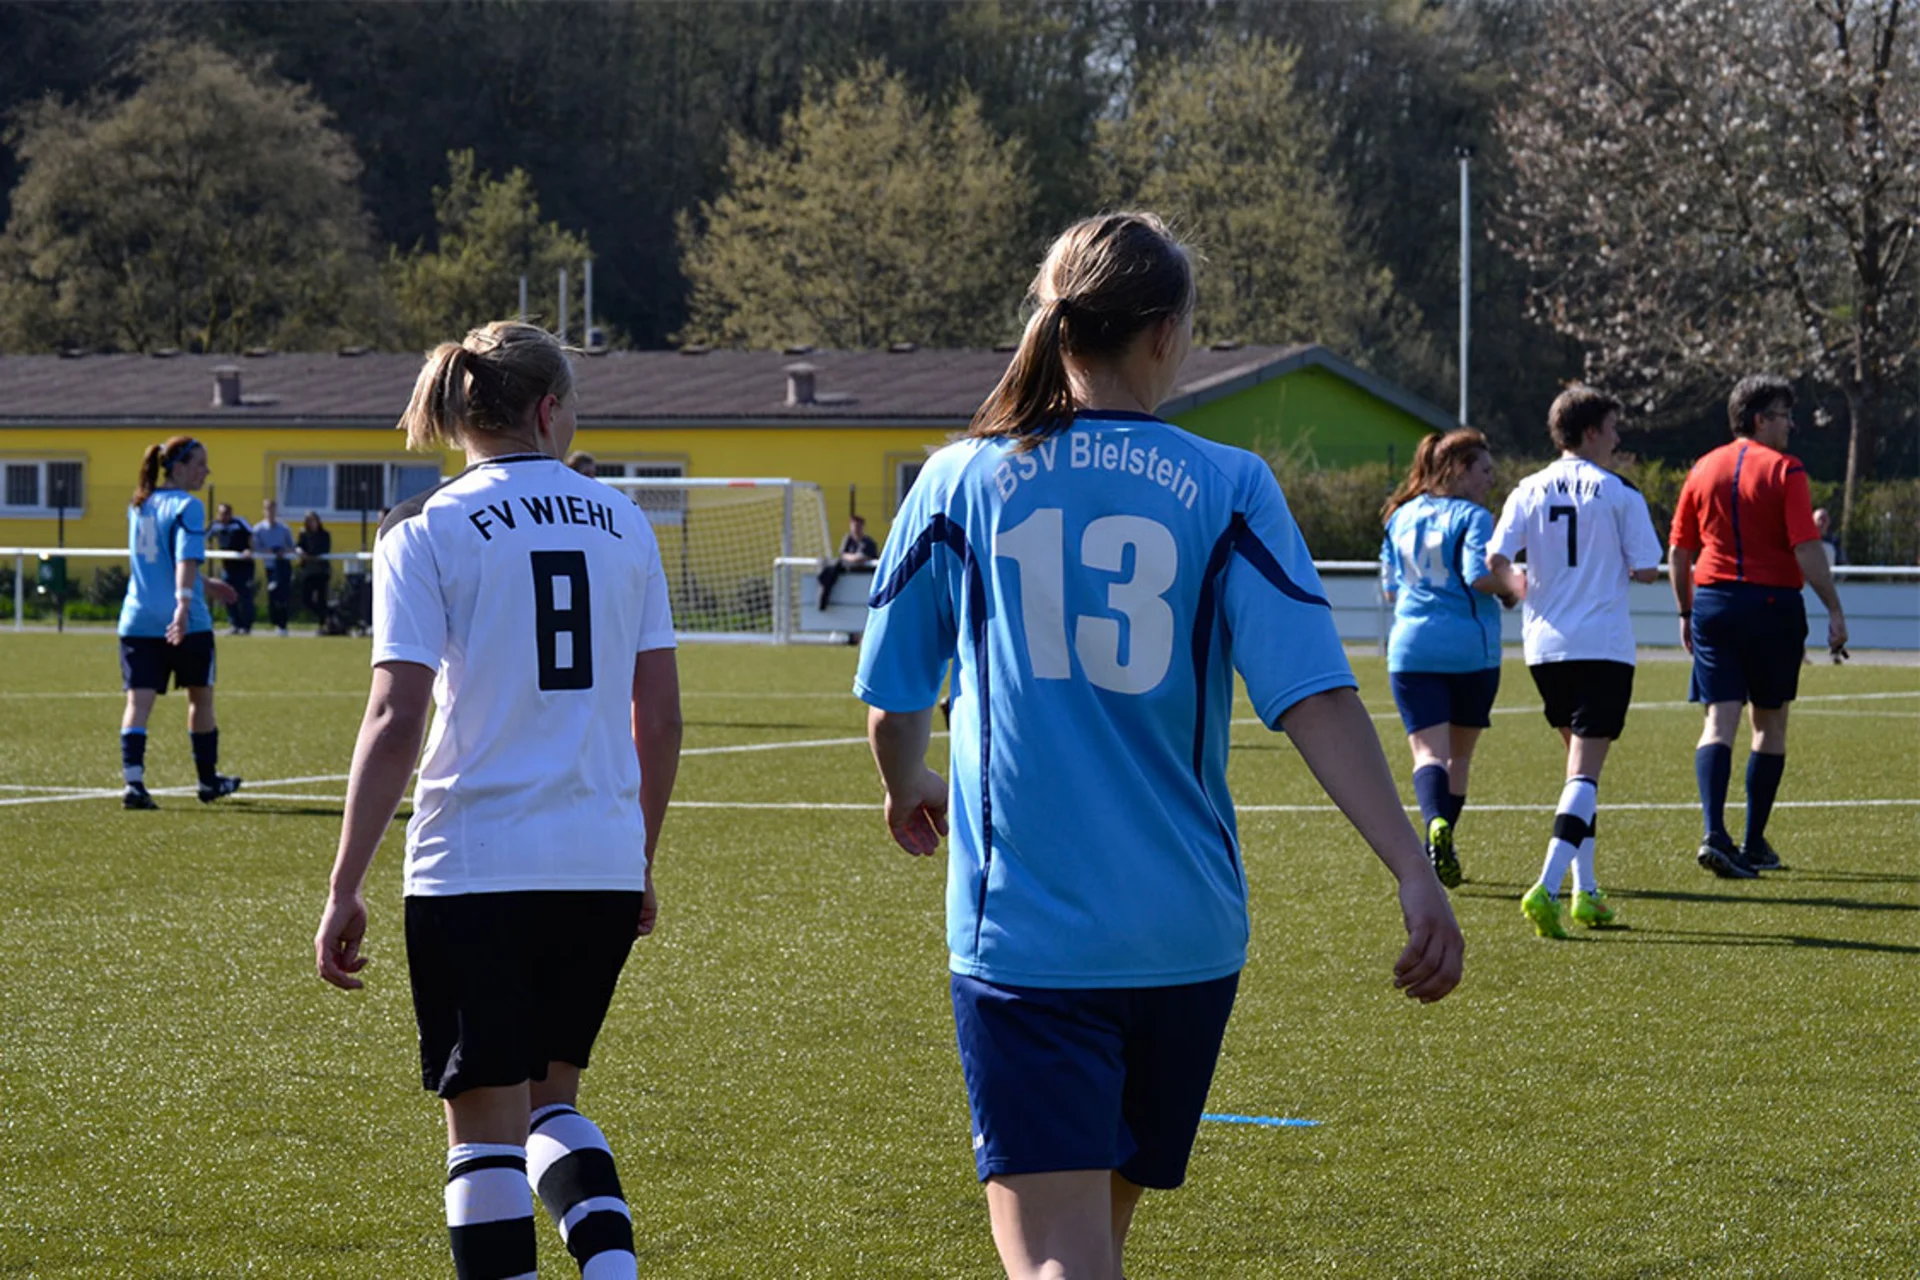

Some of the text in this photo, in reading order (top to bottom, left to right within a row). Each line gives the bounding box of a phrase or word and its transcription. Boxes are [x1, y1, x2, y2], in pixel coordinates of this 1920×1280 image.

[993, 432, 1198, 510] BSV Bielstein
[136, 516, 158, 562] 4
[469, 496, 622, 541] FV WIEHL
[1549, 506, 1577, 567] 7
[1399, 530, 1450, 588] 14
[530, 550, 593, 690] 8
[995, 508, 1177, 695] 13
